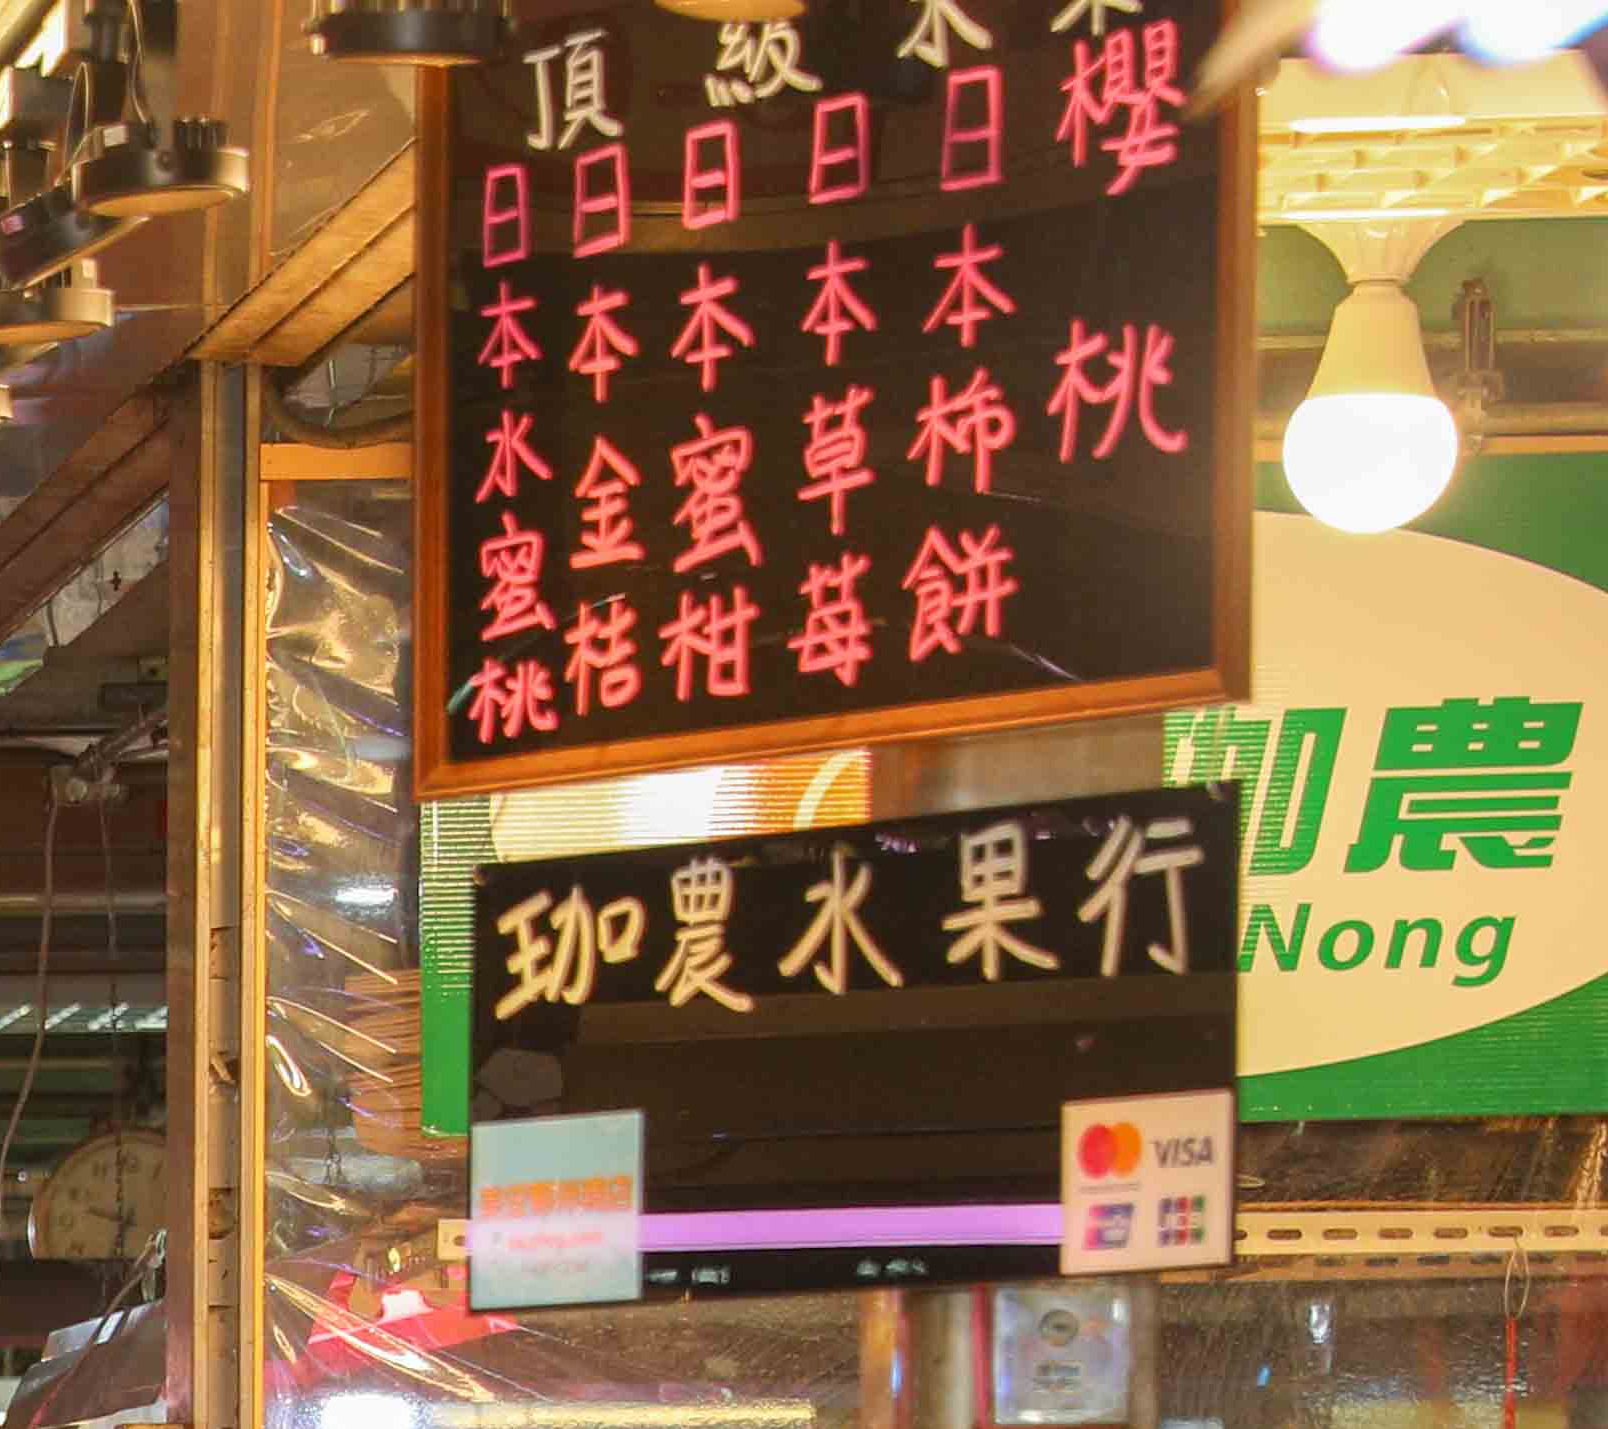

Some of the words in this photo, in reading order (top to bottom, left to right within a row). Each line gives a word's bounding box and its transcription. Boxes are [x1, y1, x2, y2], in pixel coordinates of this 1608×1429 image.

[469, 161, 558, 744] 日本水蜜桃
[564, 142, 643, 718] 日本金桔
[660, 119, 764, 699] 日本蜜柑
[901, 65, 1018, 664] 日本柿餅
[1046, 19, 1189, 463] 櫻桃
[1150, 1136, 1214, 1168] VISA
[1238, 902, 1516, 988] Nong
